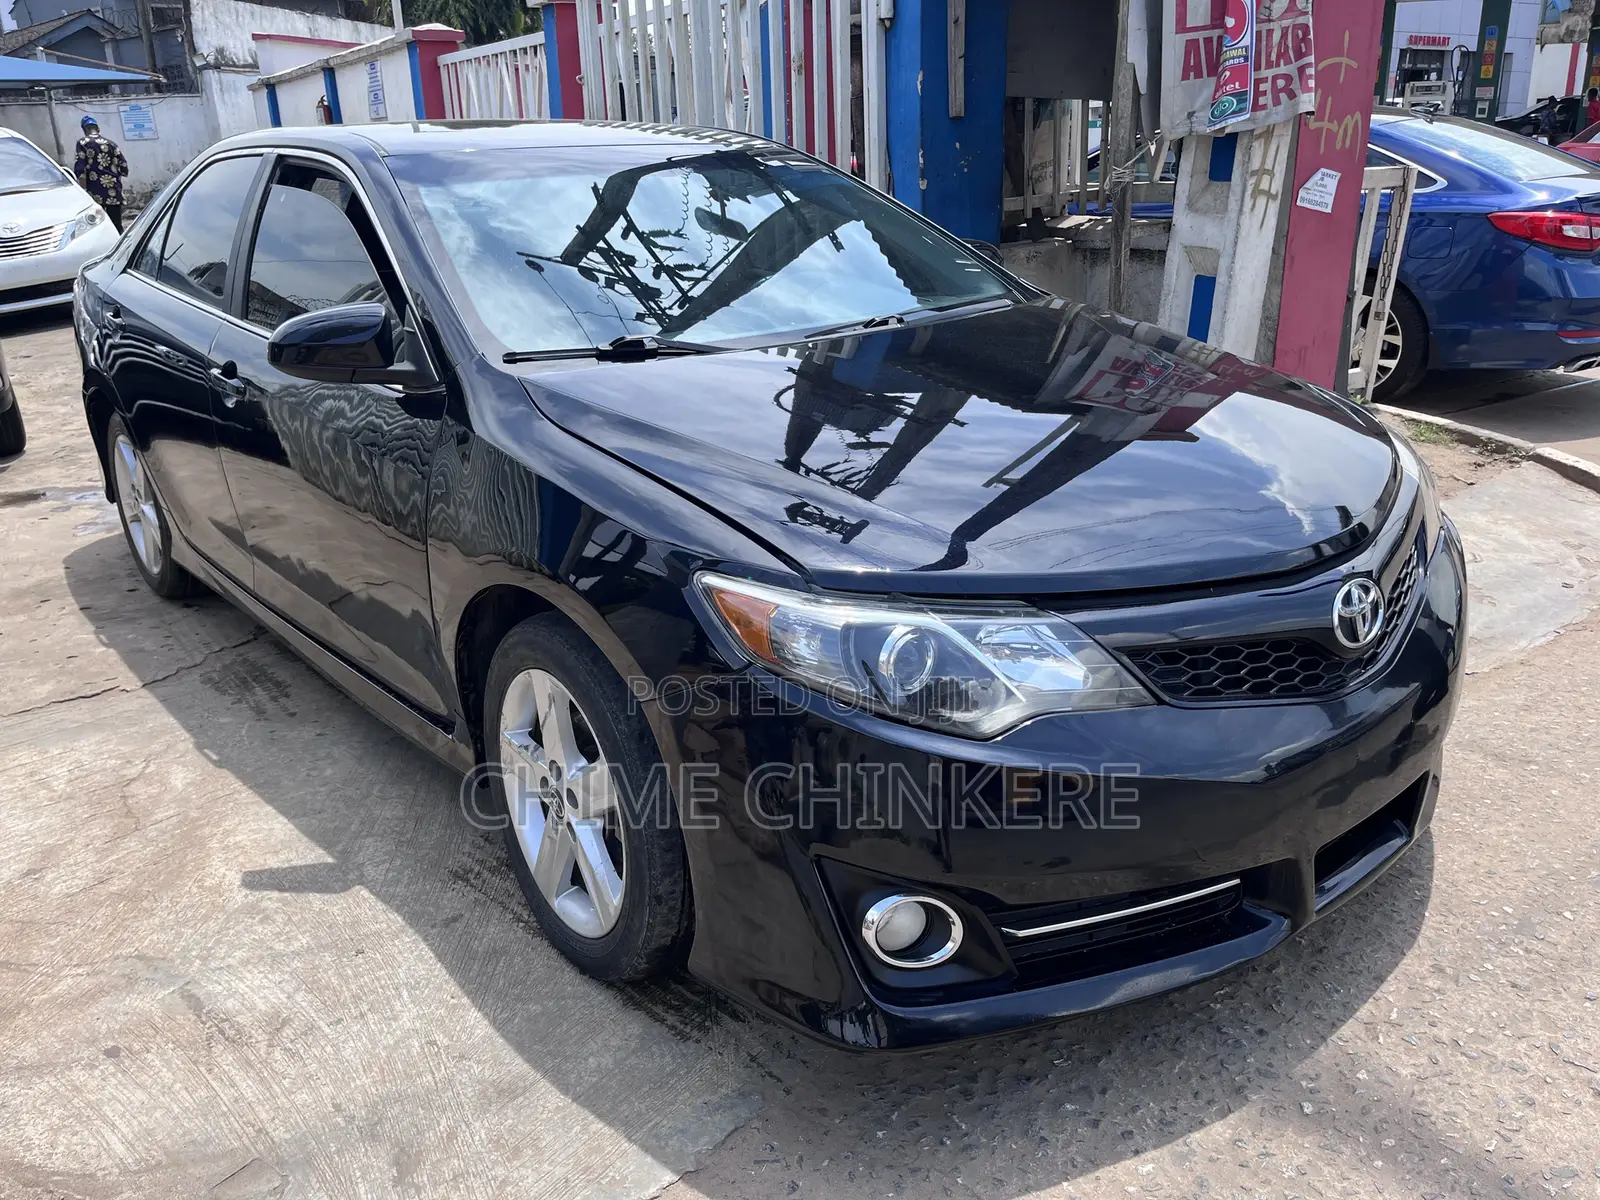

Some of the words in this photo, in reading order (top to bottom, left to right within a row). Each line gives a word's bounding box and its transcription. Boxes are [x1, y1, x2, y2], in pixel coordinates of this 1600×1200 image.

[1181, 22, 1314, 82] AVILAB
[1408, 34, 1451, 47] SUPERMART
[1251, 62, 1315, 112] ERE
[1214, 101, 1229, 116] glo
